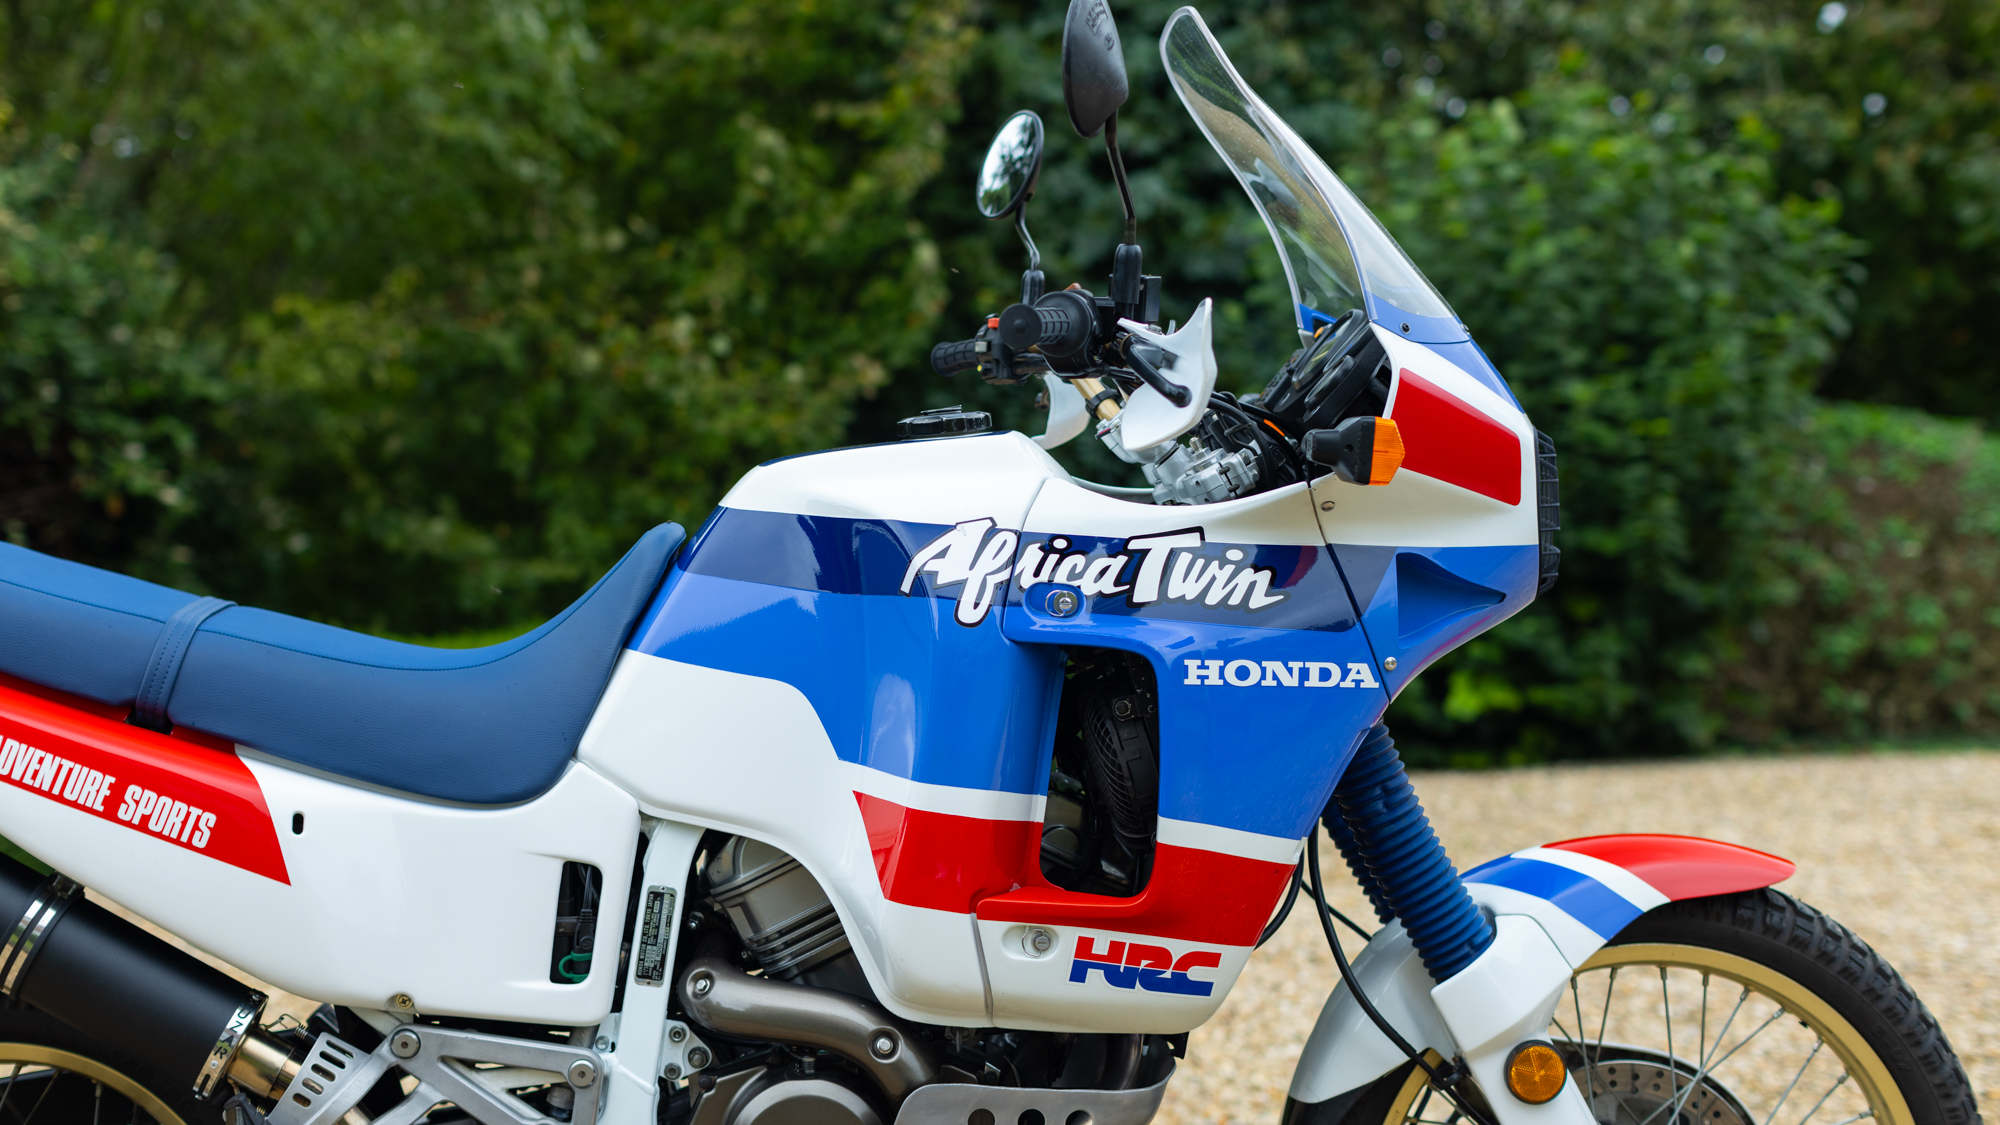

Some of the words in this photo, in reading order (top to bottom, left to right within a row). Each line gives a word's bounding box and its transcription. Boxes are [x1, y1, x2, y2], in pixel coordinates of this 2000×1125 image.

[900, 518, 1132, 627] Africa
[1125, 527, 1284, 611] Twin
[1184, 659, 1380, 688] HONDA
[0, 735, 116, 811] DVENTURE
[117, 784, 216, 848] SPORTS
[1069, 935, 1222, 997] HRC
